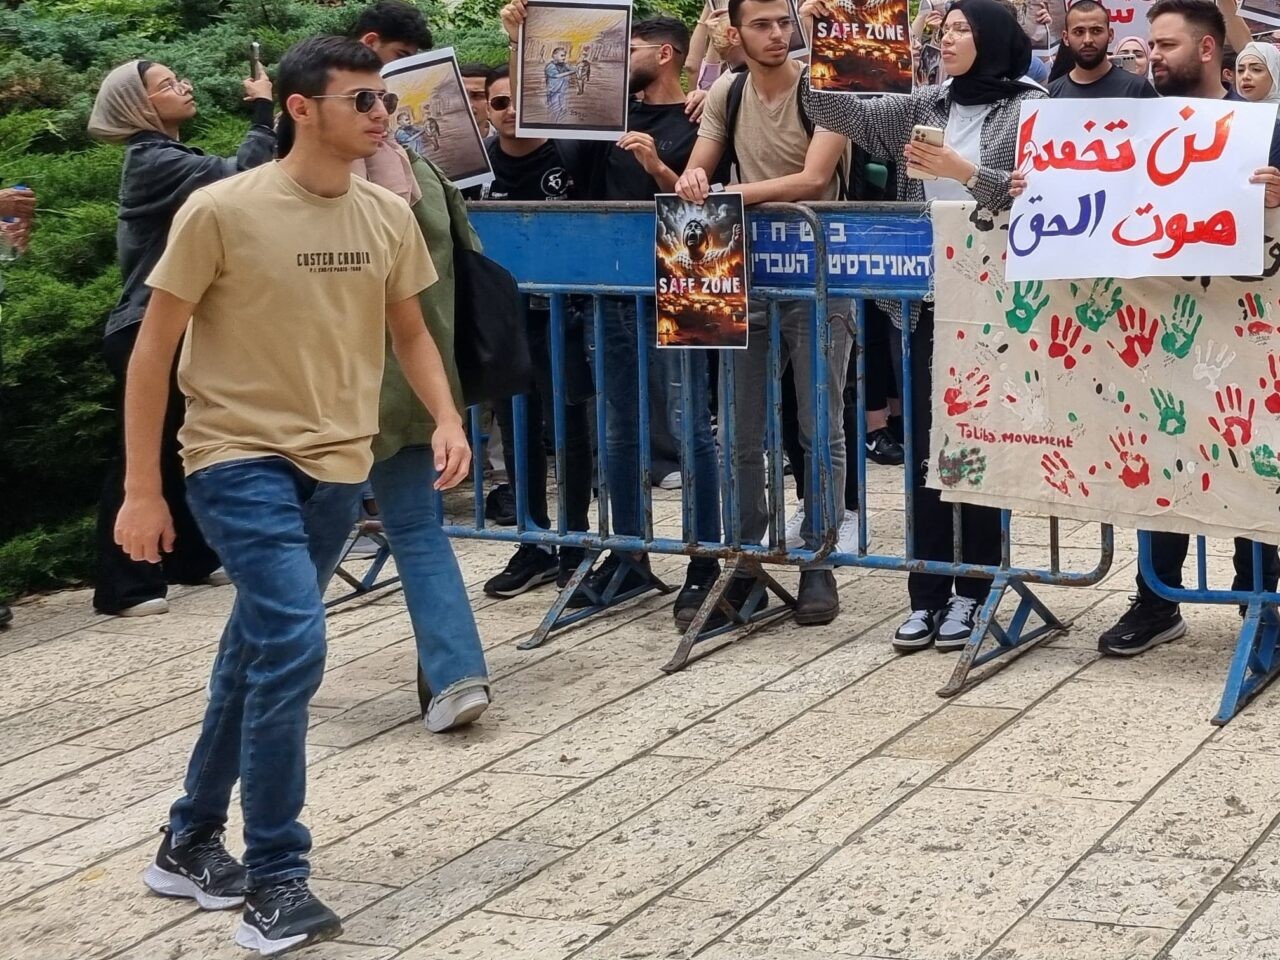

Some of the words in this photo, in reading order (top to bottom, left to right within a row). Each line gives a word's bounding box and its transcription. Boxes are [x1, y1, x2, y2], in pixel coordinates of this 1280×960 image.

[816, 21, 860, 40] SAFE
[864, 23, 905, 41] ZONE
[1146, 105, 1235, 187] لن
[752, 221, 847, 243] בטחו
[1008, 189, 1107, 257] الحق
[1111, 202, 1237, 260] صوت
[751, 252, 809, 275] העברי
[828, 254, 930, 277] האוניברסיט
[658, 276, 696, 295] SAFE
[701, 276, 741, 294] ZONE
